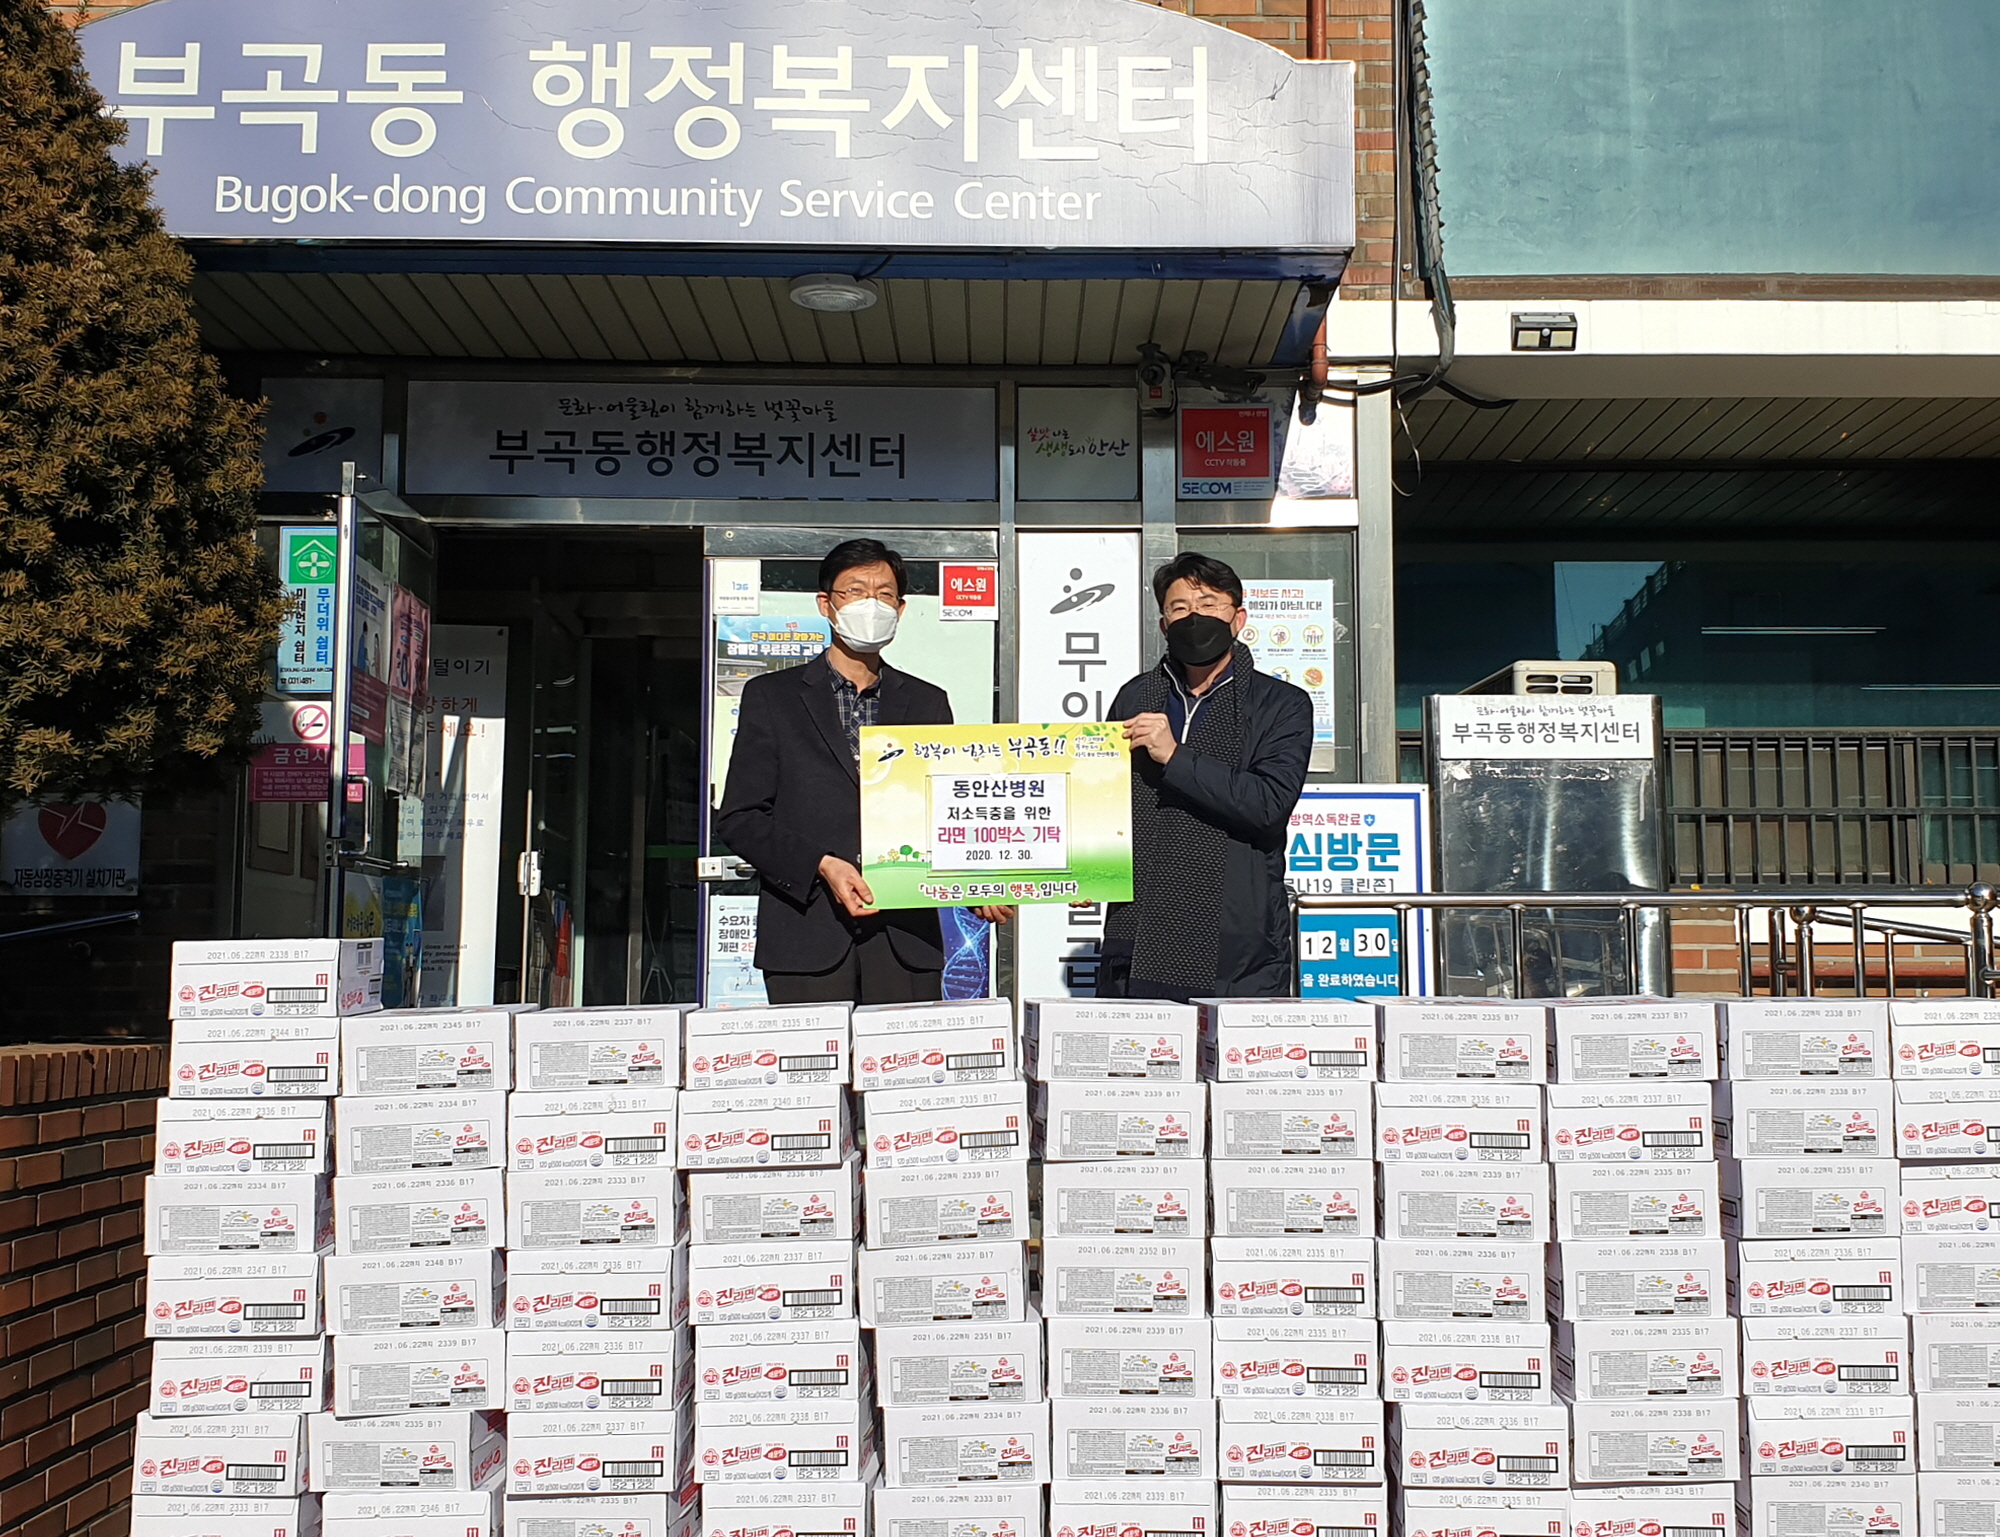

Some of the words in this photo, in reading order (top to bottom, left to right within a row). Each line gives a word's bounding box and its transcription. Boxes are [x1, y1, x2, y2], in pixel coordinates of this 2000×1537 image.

[103, 42, 464, 158] 부곡동
[529, 40, 1207, 164] 행정복지센터
[215, 174, 486, 225] Bugok-dong
[505, 176, 763, 228] Community
[779, 179, 935, 221] Service
[953, 180, 1103, 222] Center
[684, 397, 757, 421] 함께하는
[764, 397, 838, 423] 벚꽃마을
[1027, 427, 1050, 443] 살맛
[1052, 429, 1070, 440] 나는
[1195, 430, 1255, 453] 에스원
[489, 429, 907, 480] 부곡동행정복지센터
[1088, 438, 1131, 457] 안산
[1204, 458, 1225, 467] CCTV
[1182, 482, 1232, 495] SECOM
[950, 577, 987, 592] 에스원
[1250, 588, 1279, 599] 킥보드
[1281, 588, 1304, 599] 사고!
[316, 588, 331, 632] 무더위
[942, 608, 973, 617] SECOM
[1280, 600, 1322, 611] 아닙니다!
[294, 641, 305, 665] 쉼터
[316, 635, 330, 665] 쉼터
[727, 643, 758, 656] 장애인
[760, 643, 801, 656] 무료운전
[1538, 705, 1576, 717] 함께하는
[1578, 705, 1616, 718] 벚꽃마을
[1452, 721, 1641, 744] 부곡동행정복지센터
[913, 743, 957, 760] 행복이
[962, 743, 1002, 759] 넘치는
[1007, 736, 1066, 759] 부곡동!!
[952, 779, 1046, 799] 동안산병원
[947, 806, 1016, 821] 저소득층을
[1024, 806, 1051, 820] 위한
[1289, 813, 1361, 827] 방역소독완료
[937, 827, 966, 844] 라면
[974, 827, 1026, 844] 100박스
[1032, 827, 1061, 844] 기탁
[965, 850, 993, 861] 2020.
[999, 850, 1013, 861] 12.
[1018, 850, 1033, 861] 30.
[13, 868, 83, 889] 자동심장충격기
[86, 868, 126, 888] 설치기관
[967, 883, 1005, 897] 모두의
[718, 915, 751, 926] 수요자
[718, 928, 751, 940] 장애인
[718, 942, 739, 953] 개편
[1305, 936, 1333, 955] 12
[1339, 938, 1350, 952] 월
[1358, 933, 1386, 952] 30
[294, 950, 309, 959] B17
[1317, 973, 1398, 988] 완료하였습니다
[198, 981, 240, 1000] 진라면
[970, 1016, 984, 1025] B17
[1673, 1011, 1688, 1020] B17
[465, 1020, 481, 1029] B17
[1244, 1044, 1283, 1064] 진라면
[880, 1053, 920, 1072] 진라면
[1328, 1088, 1344, 1097] B17
[796, 1096, 811, 1105] B17
[704, 1130, 744, 1149] 진라면
[1574, 1122, 1616, 1144] 진라면
[1859, 1166, 1873, 1174] B17
[1161, 1247, 1177, 1256] B17
[1500, 1250, 1516, 1259] B17
[271, 1266, 287, 1275] B17
[1767, 1278, 1807, 1298] 진라면
[174, 1297, 216, 1317] 진라면
[815, 1331, 830, 1340] B17
[1168, 1327, 1184, 1335] B17
[722, 1365, 763, 1384] 진라면
[1006, 1411, 1022, 1419] B17
[1778, 1440, 1819, 1460] 진라면
[1873, 1480, 1889, 1489] B17
[445, 1503, 460, 1512] B17
